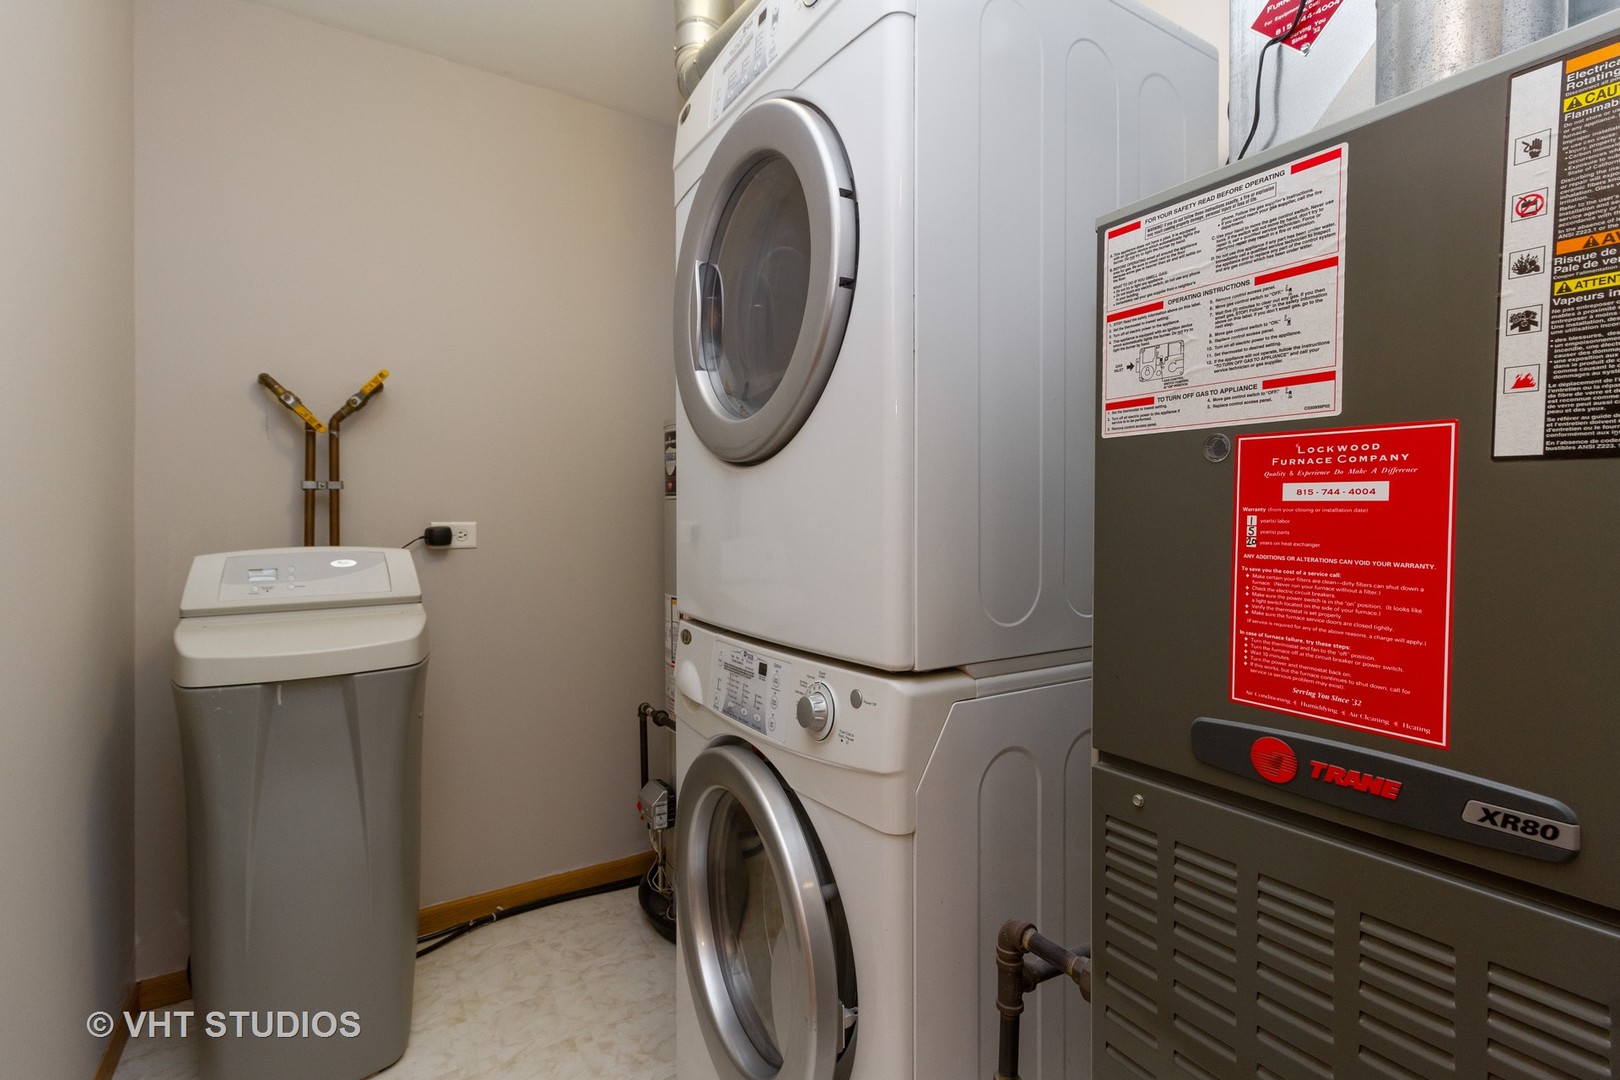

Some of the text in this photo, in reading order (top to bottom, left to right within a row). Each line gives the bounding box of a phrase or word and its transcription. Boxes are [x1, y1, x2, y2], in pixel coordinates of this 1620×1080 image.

[1314, 18, 1326, 26] You
[1292, 34, 1307, 44] Since
[1566, 69, 1620, 91] Rotating
[1584, 83, 1620, 104] CAU
[1145, 170, 1285, 224] FOR YOUR SAFETY READ BEFORE OPERATING
[1554, 246, 1616, 267] Risque de
[1554, 257, 1620, 274] Pale de ve
[1168, 279, 1250, 305] OPERATING INSTRUCTIONS
[1553, 290, 1604, 307] Vapeurs
[1219, 384, 1257, 395] APPLIANCE
[1297, 441, 1380, 453] LOCKWOOD
[1272, 452, 1409, 466] FURNACE COMPANY
[1296, 469, 1329, 477] Experience
[1248, 526, 1254, 535] 5
[1285, 636, 1304, 644] failure,
[1330, 694, 1349, 703] Since
[1254, 692, 1290, 705] Conditioning
[1300, 701, 1337, 714] Humidifying
[1359, 713, 1389, 725] Cleaning
[1402, 722, 1430, 734] Heating
[1310, 760, 1402, 800] TRANE
[1476, 808, 1560, 841] XR80
